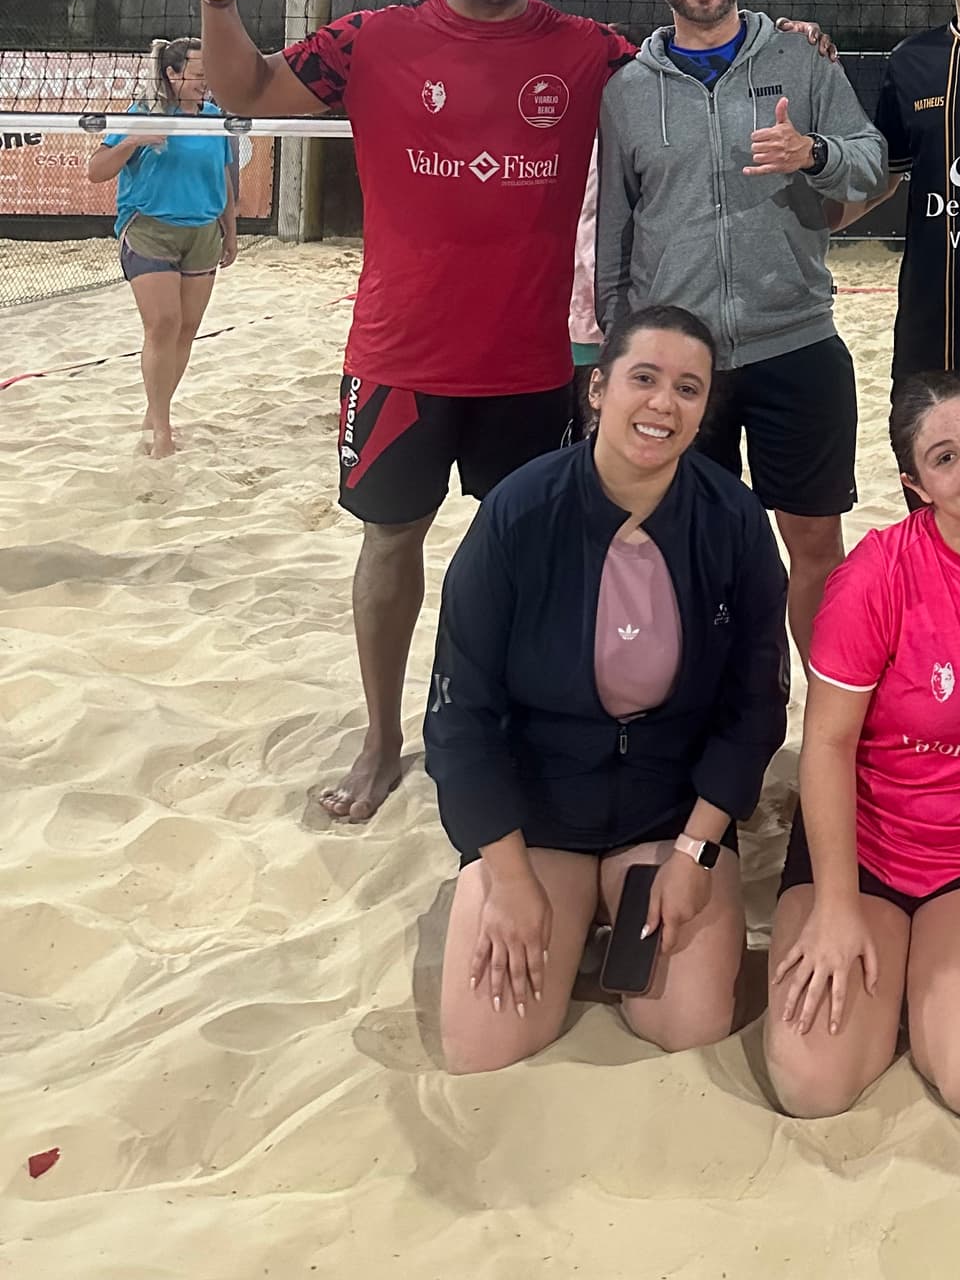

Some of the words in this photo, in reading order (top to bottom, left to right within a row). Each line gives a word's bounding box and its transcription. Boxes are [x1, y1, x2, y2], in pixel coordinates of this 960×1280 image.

[914, 96, 945, 112] MATHEUS
[406, 148, 466, 179] Valor
[501, 153, 560, 179] Fiscal
